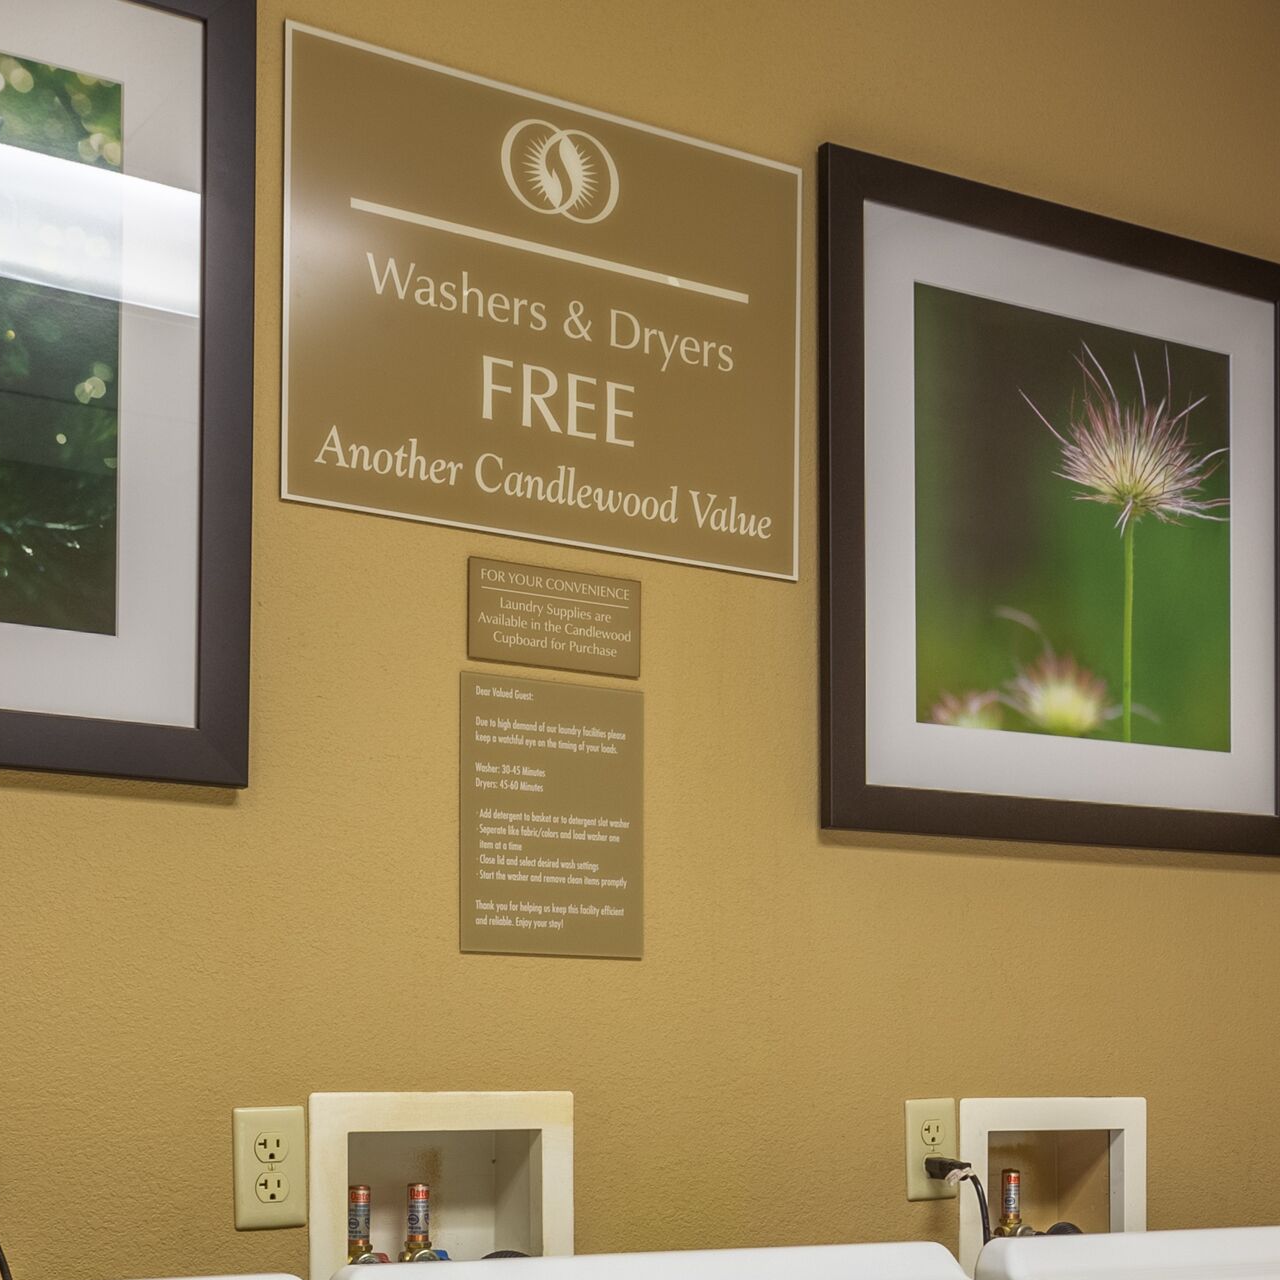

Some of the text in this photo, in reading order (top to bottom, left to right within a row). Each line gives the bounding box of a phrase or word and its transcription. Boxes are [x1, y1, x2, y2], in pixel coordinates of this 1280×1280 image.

[366, 252, 735, 373] Washers & Dryers
[481, 354, 636, 448] FREE
[314, 424, 773, 540] Another Candlewood Value
[481, 568, 630, 601] FOR YOUR CONVENIENCE
[500, 597, 612, 624] Laundry Supplies are
[477, 611, 632, 643] Available in the Candlewood
[493, 630, 618, 658] Cupboard for Purchase
[475, 685, 534, 701] Dear Valued Guest:
[475, 716, 488, 727] Due
[489, 718, 497, 727] to
[497, 717, 512, 732] high
[512, 719, 537, 732] demand
[538, 722, 545, 732] of
[558, 723, 582, 738] laundry
[582, 725, 607, 738] facilities
[607, 729, 626, 740] please
[475, 730, 618, 754] keep a watchful eye on the timing of your loads.
[475, 761, 546, 778] Washer: 30-45 Minutes
[475, 777, 544, 793] Dryers: 45-60 Minutes
[479, 808, 630, 829] Add detergent to basket or to detergent slot washer
[507, 824, 520, 836] like
[520, 825, 559, 839] fabric/colors
[560, 829, 572, 840] and
[572, 829, 586, 841] load
[586, 831, 608, 842] washer
[608, 835, 620, 843] one
[479, 839, 494, 849] item
[494, 841, 502, 850] at
[508, 841, 523, 851] time
[479, 854, 600, 873] Close lid and select desired wash settings
[479, 869, 628, 889] Start the washer and remove clean items promptly
[475, 899, 625, 918] Thank you for helping us keep this facility efficient
[475, 914, 564, 931] and reliable. Enjoy your stay!
